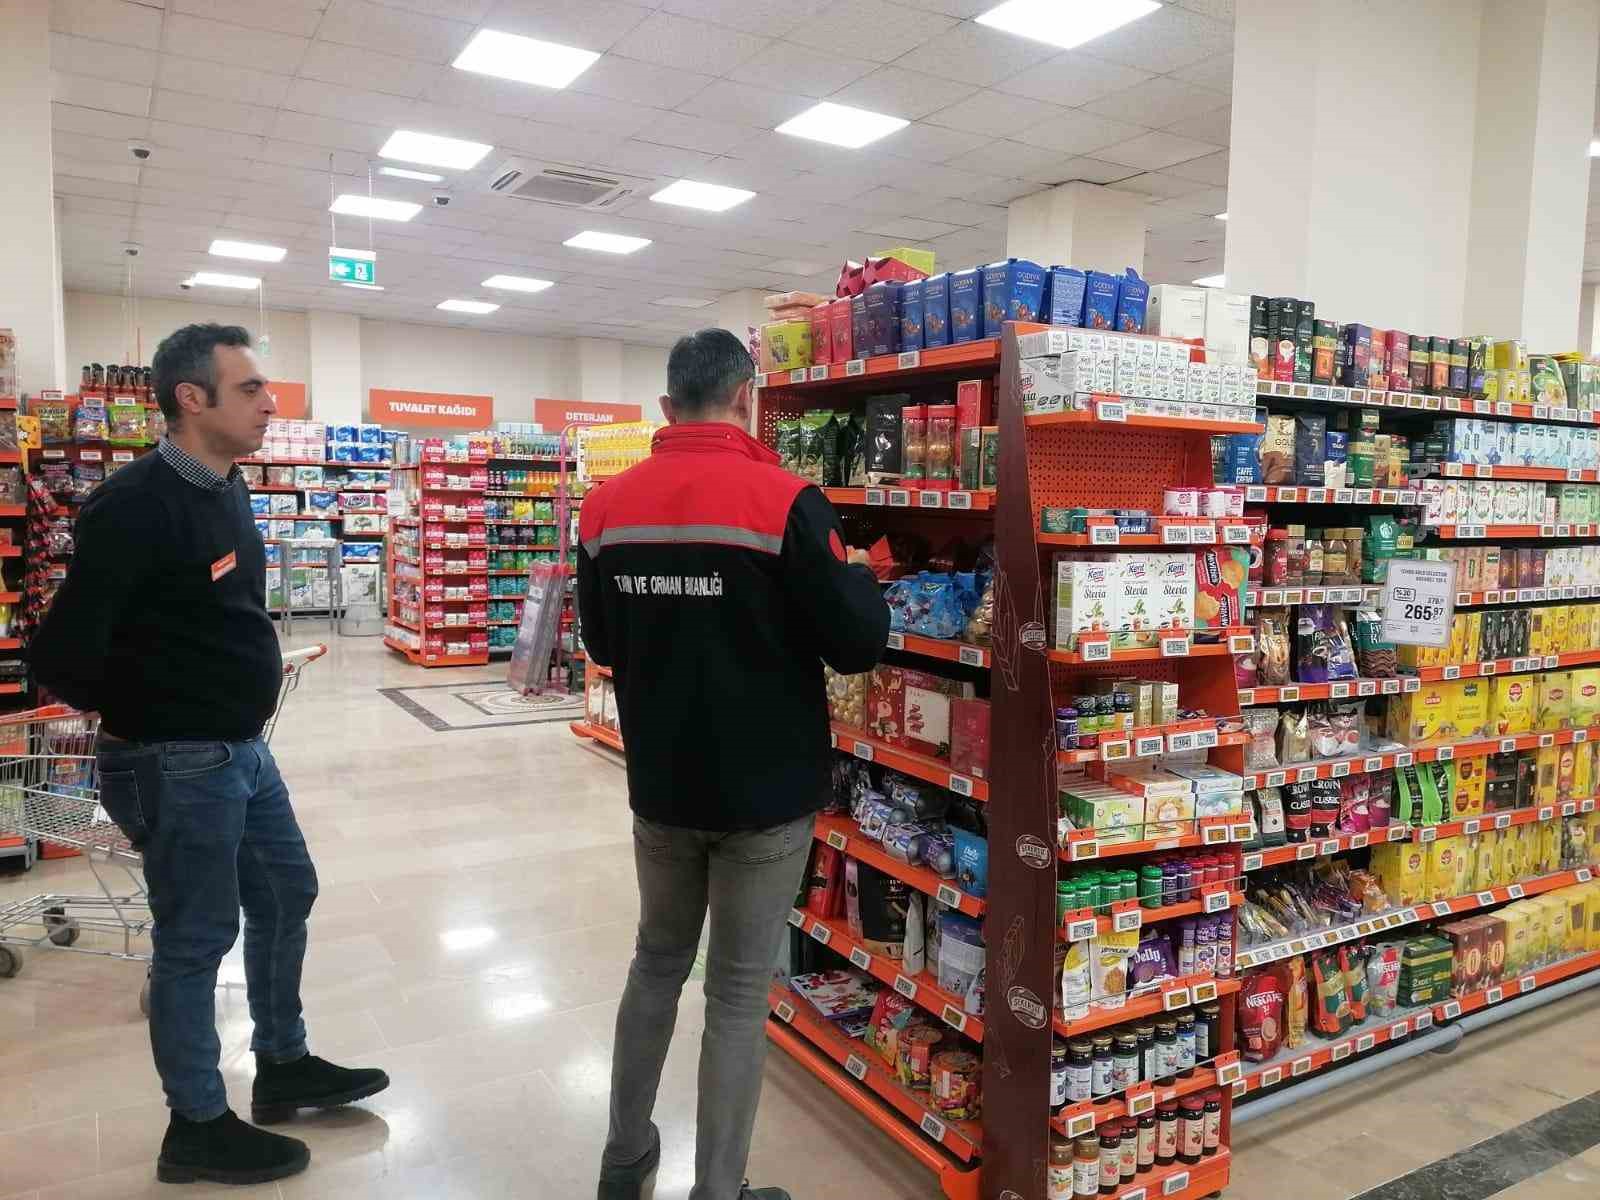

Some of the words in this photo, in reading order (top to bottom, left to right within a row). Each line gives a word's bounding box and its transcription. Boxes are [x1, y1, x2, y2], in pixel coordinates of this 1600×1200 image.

[388, 401, 437, 415] TUVALET
[438, 403, 477, 417] KAĞIDI
[565, 411, 614, 422] DETERJAN
[634, 576, 648, 595] VE
[650, 575, 682, 595] ORMAN
[1125, 585, 1149, 596] Stevia
[1163, 585, 1188, 595] Stevia
[1084, 589, 1106, 599] Stevia
